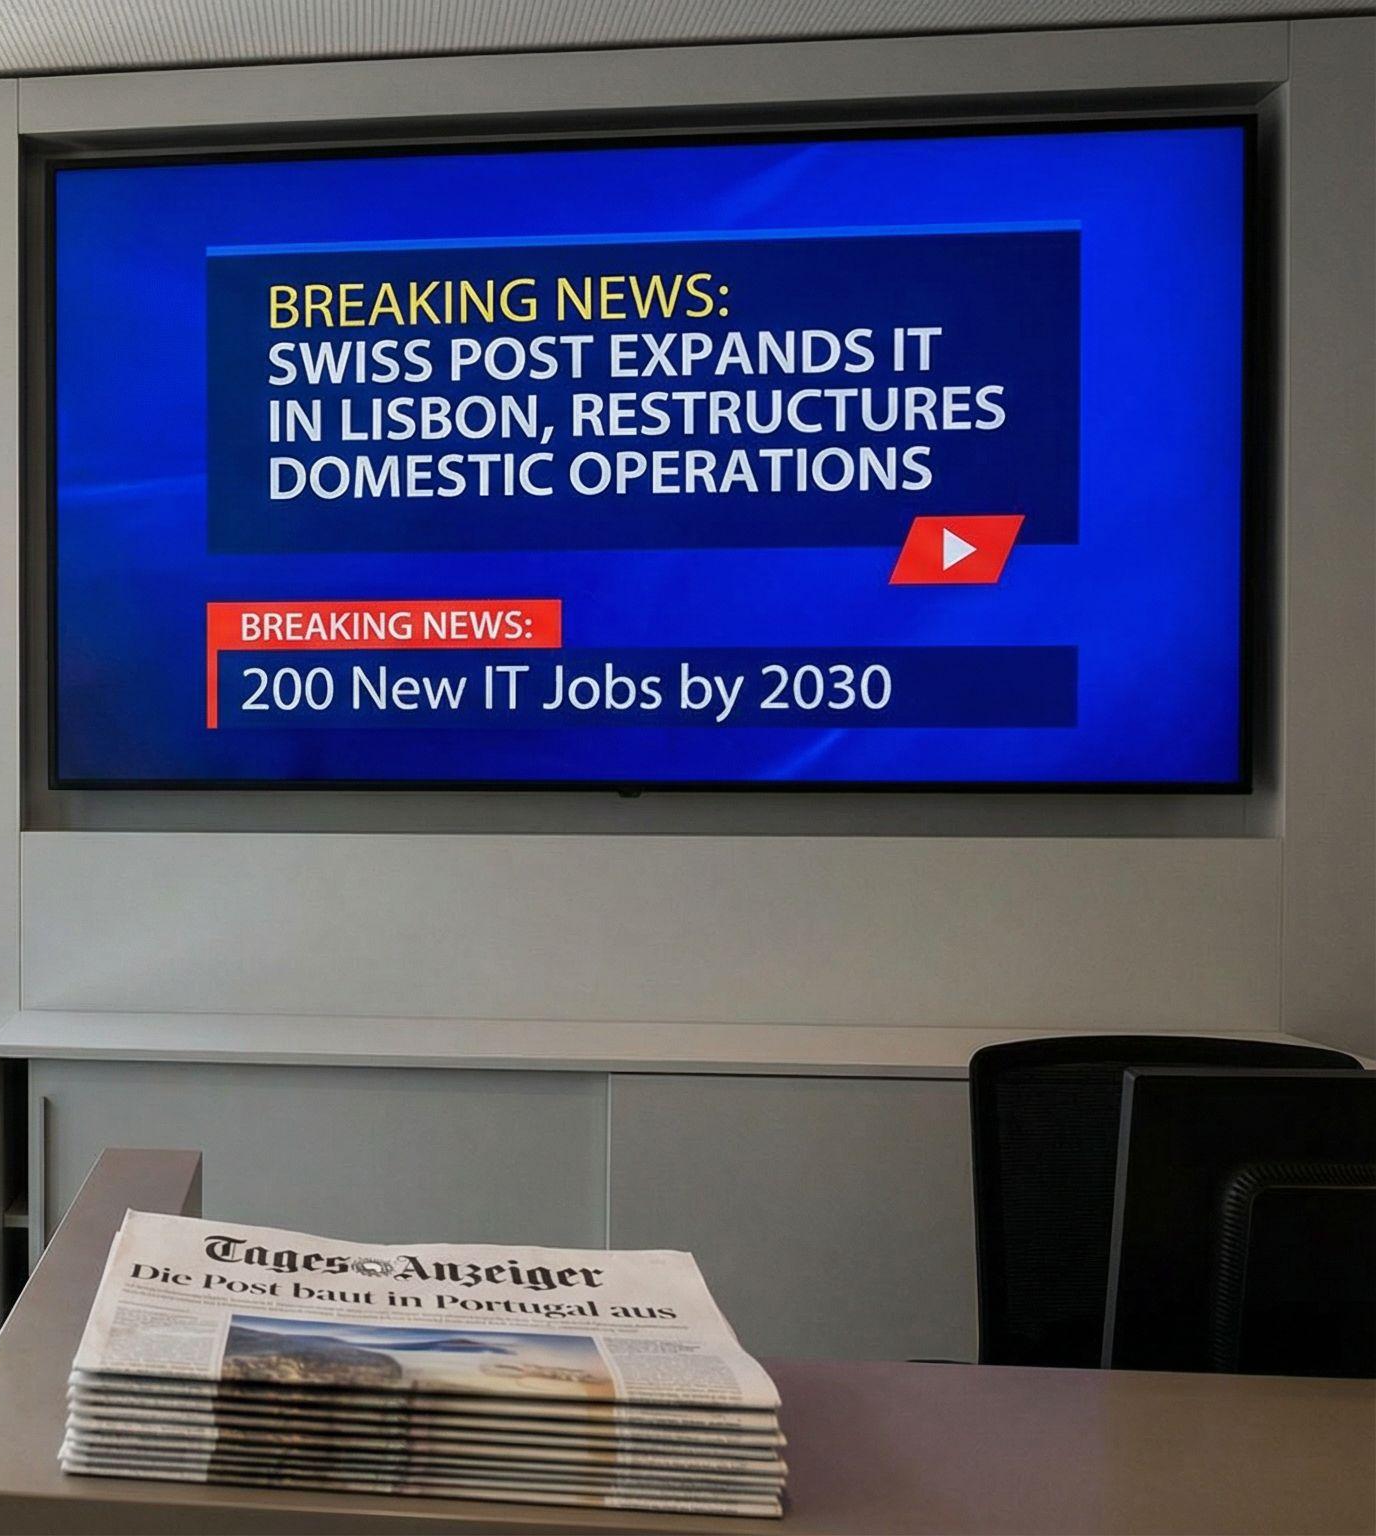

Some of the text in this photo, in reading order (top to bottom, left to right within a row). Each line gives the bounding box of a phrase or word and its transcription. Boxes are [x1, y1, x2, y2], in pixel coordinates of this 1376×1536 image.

[270, 273, 730, 329] BREAKING NEWS:
[268, 326, 943, 386] SWISS POST EXPANDS IT
[269, 384, 1006, 446] IN LISBON, RESTRUCTURES
[269, 445, 933, 500] DOMESTIC OPERATIONS
[241, 610, 533, 642] BREAKING NEWS:
[241, 662, 892, 723] 200 New IT Jobs by 2030
[203, 1235, 604, 1290] Tages Anzeiger
[130, 1263, 193, 1286] Die
[202, 1275, 281, 1297] Post
[292, 1281, 373, 1305] baut
[387, 1291, 423, 1308] in
[436, 1294, 600, 1319] Portugal
[609, 1305, 678, 1321] aus
